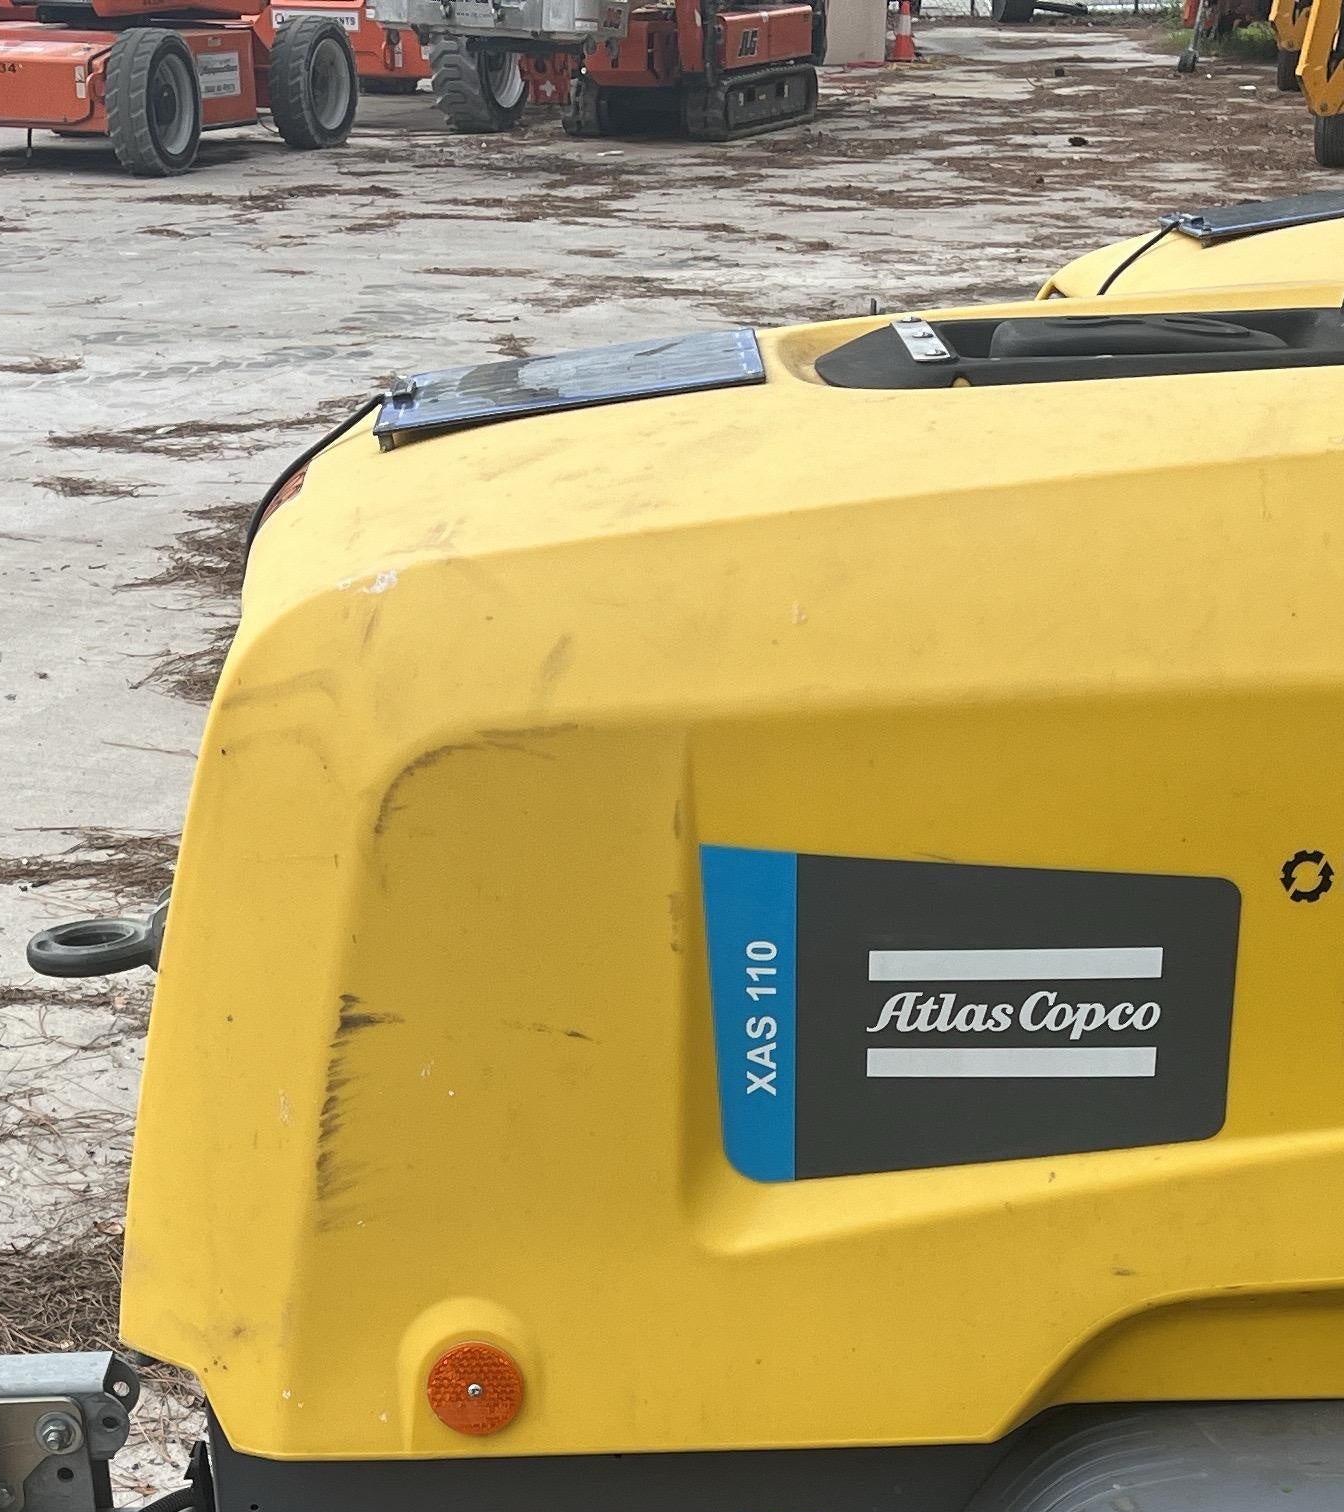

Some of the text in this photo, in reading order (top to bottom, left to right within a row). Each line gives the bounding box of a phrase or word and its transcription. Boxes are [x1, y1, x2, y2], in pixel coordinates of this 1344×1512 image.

[746, 941, 777, 1097] XAS 110
[866, 990, 1161, 1041] Atlas Copco
